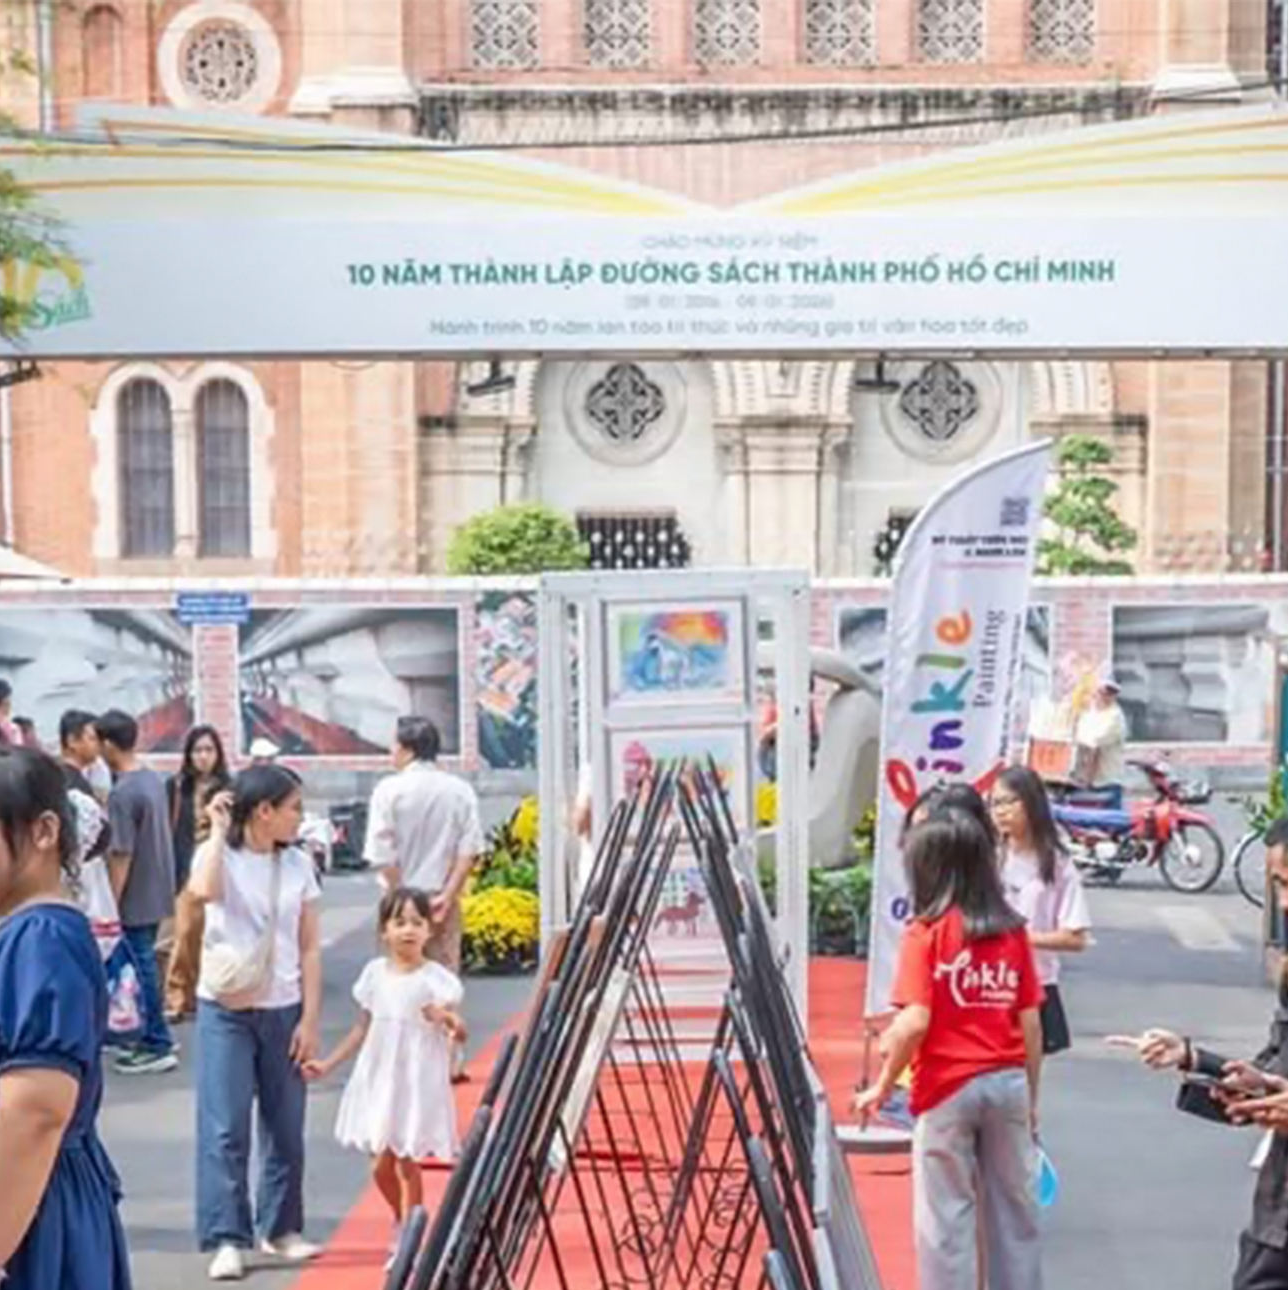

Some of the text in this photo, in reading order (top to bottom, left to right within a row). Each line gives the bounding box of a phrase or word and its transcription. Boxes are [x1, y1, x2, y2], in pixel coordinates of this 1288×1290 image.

[348, 251, 1114, 290] 10 NĂM THÀNH LẬP ĐƯỜNG SÁCH THÀNH PHỐ HỒ CHÍ MINH
[529, 318, 548, 335] 10
[972, 609, 1006, 708] Painting
